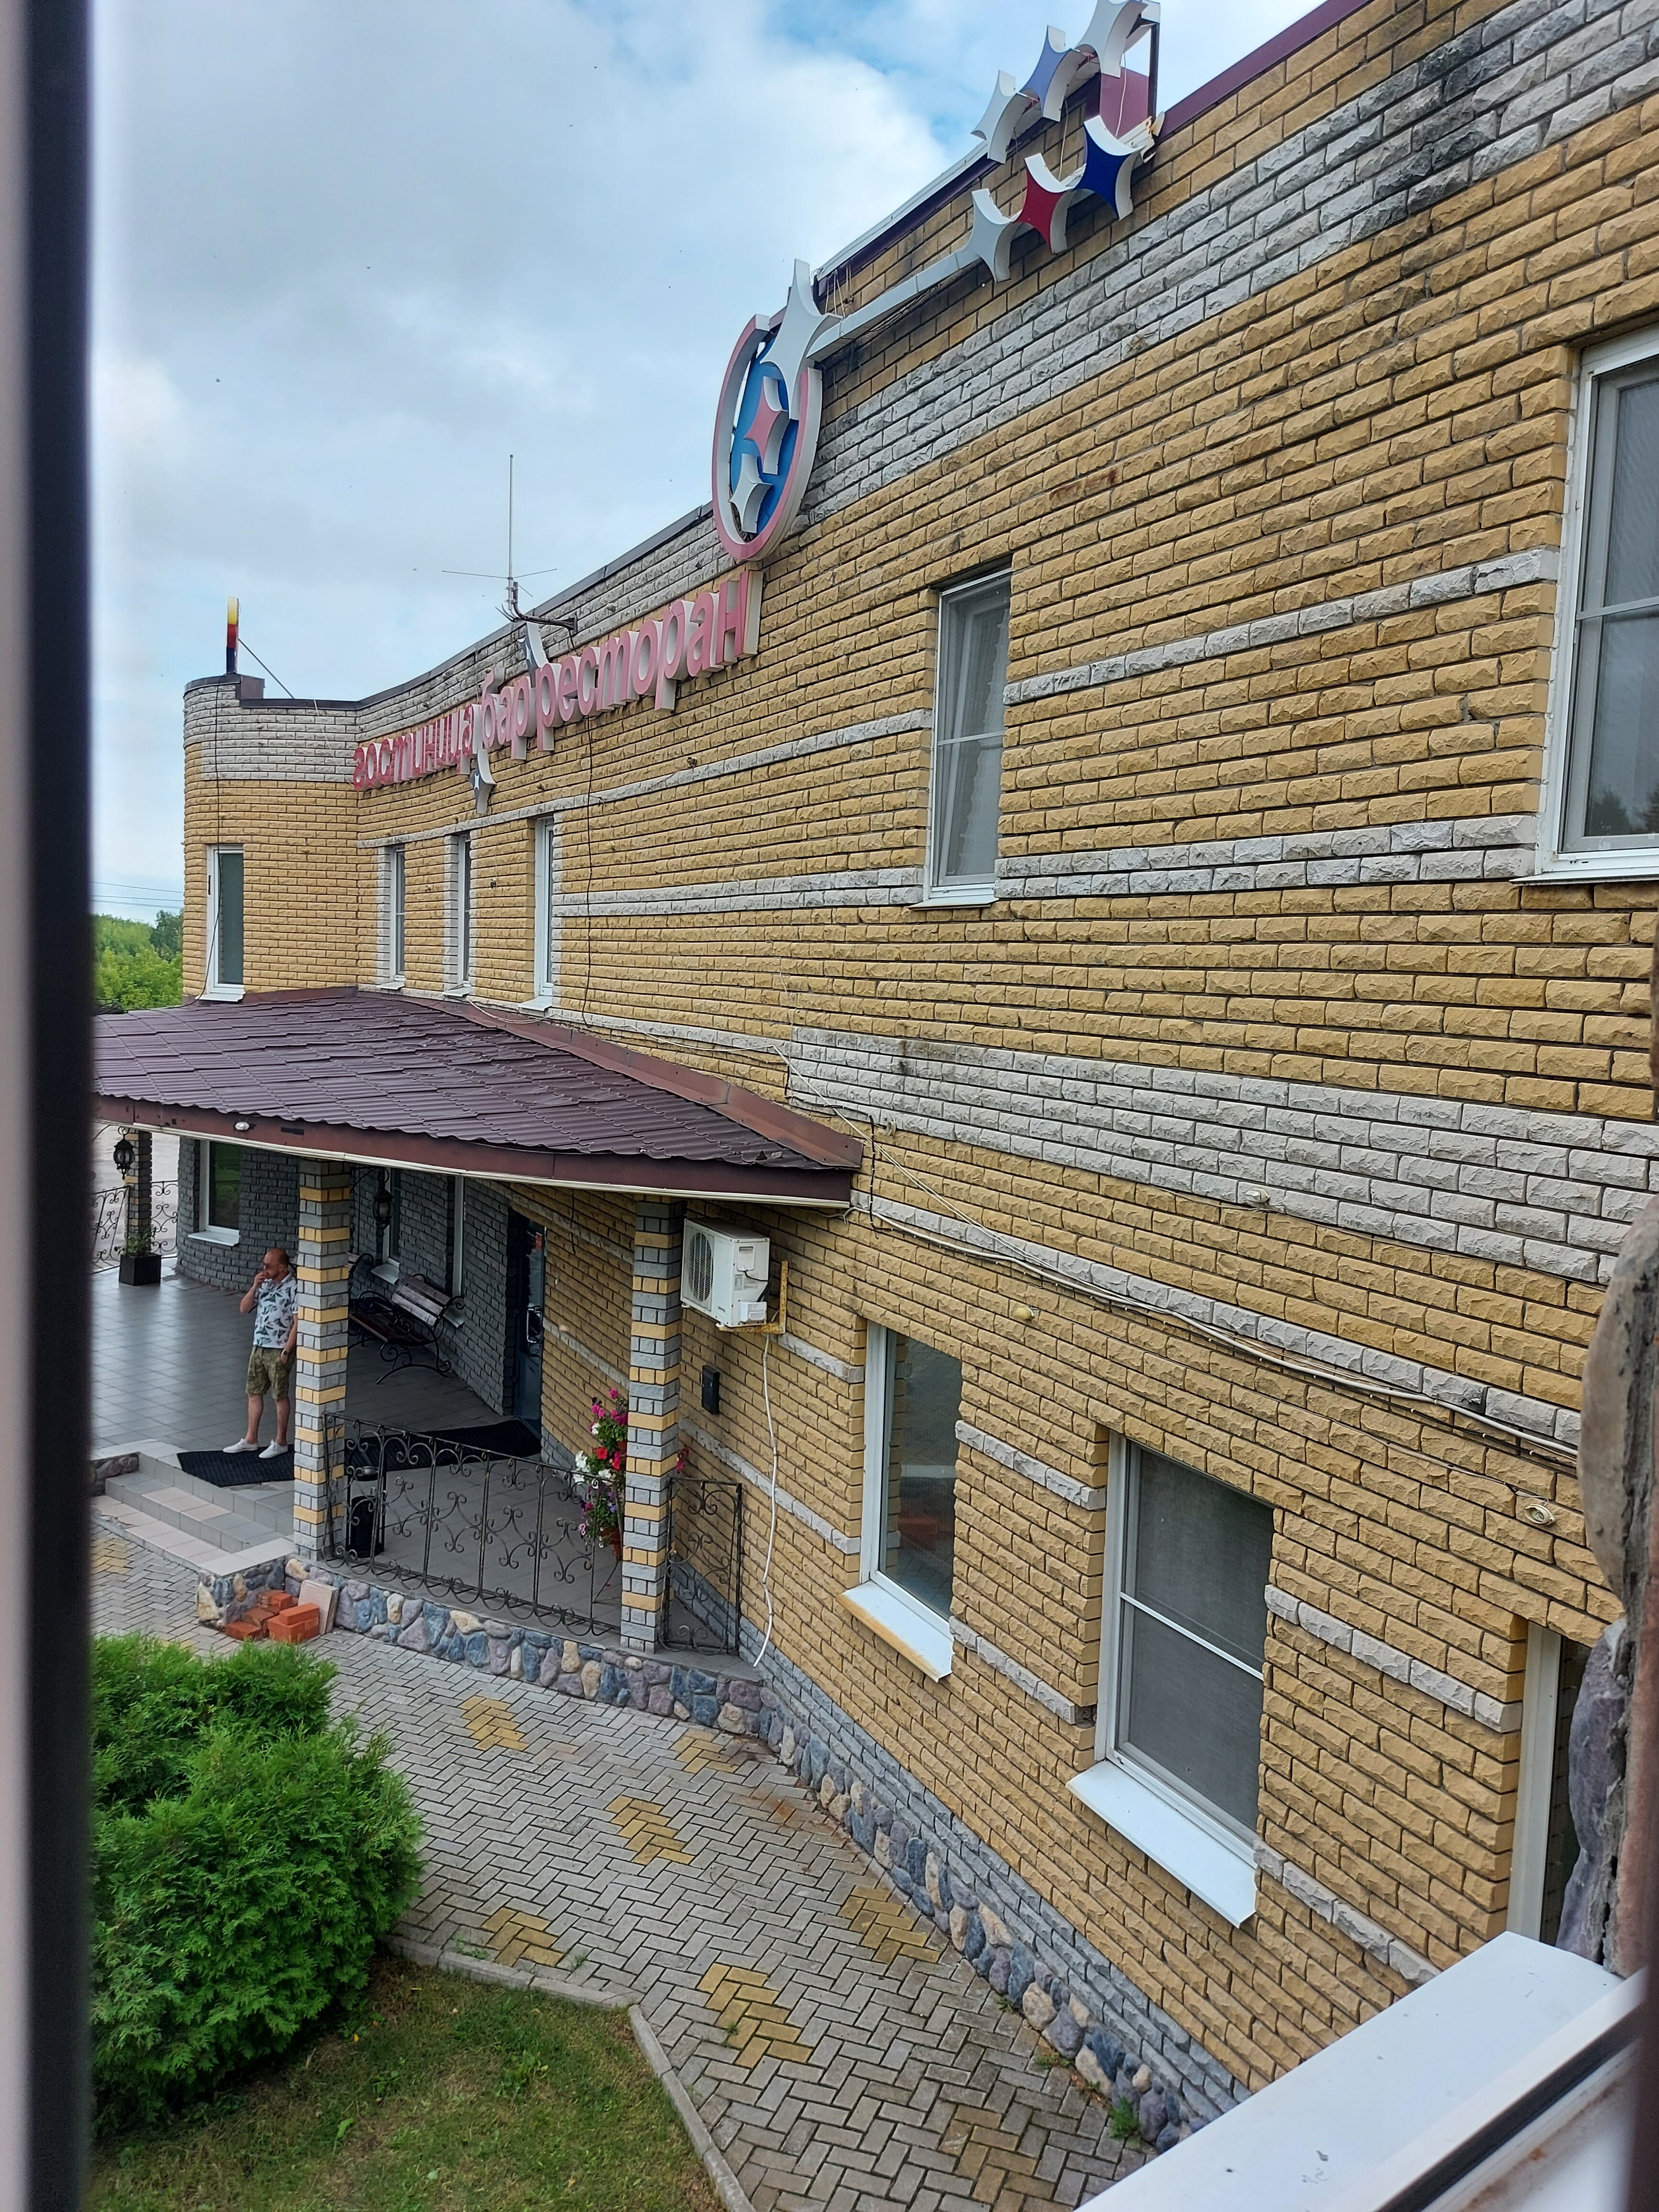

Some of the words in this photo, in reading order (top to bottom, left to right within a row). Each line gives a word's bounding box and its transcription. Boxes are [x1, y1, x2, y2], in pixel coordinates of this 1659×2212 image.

[353, 704, 481, 791] гостиница
[482, 664, 534, 760] бар
[535, 570, 762, 752] ресторан
